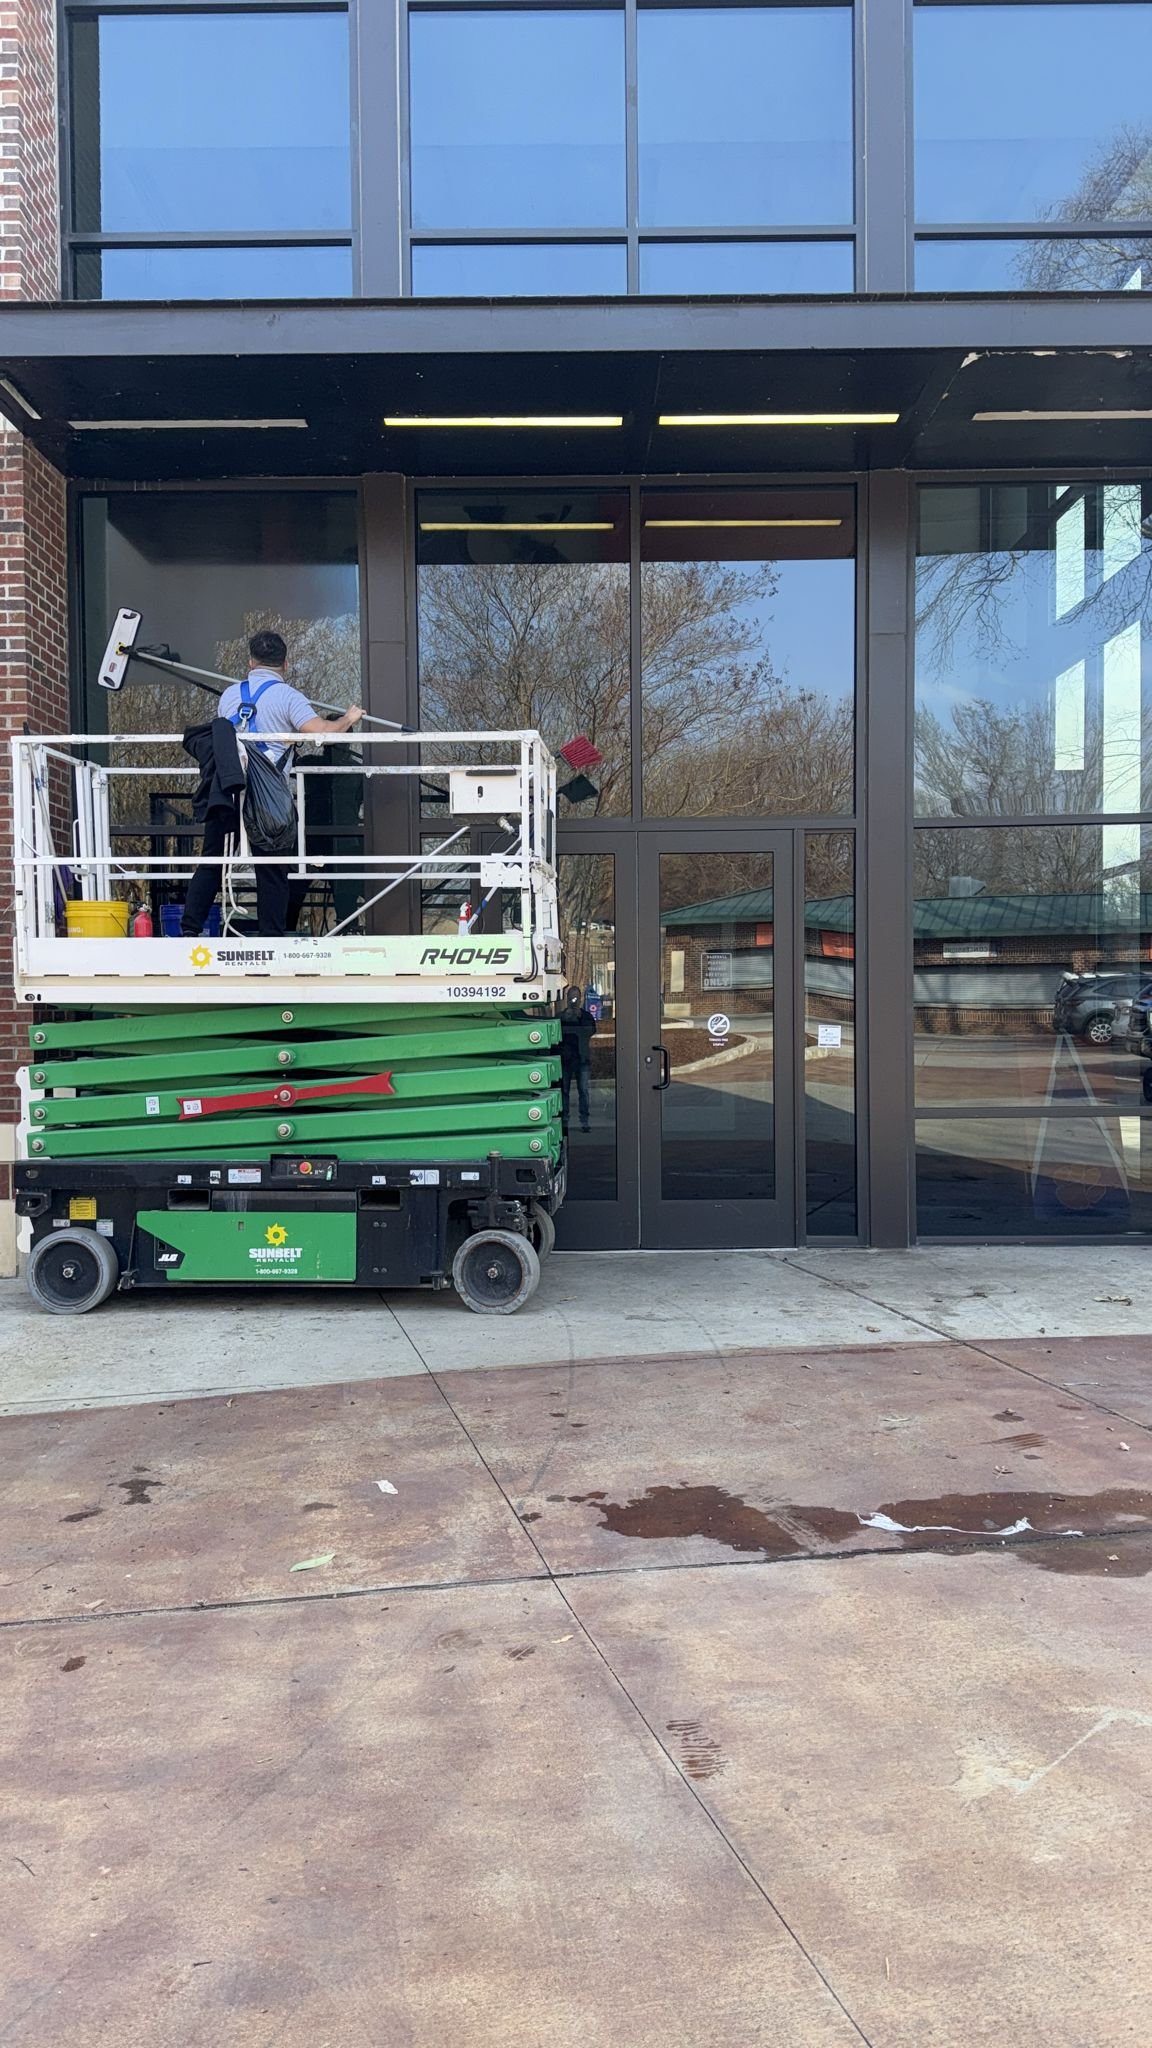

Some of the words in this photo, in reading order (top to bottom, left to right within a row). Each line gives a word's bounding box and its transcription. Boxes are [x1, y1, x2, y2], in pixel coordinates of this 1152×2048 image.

[217, 950, 275, 962] SUNBELT
[420, 948, 512, 965] R4045
[704, 978, 729, 986] ONLY
[446, 986, 506, 997] 10394192
[158, 1253, 178, 1262] JLG
[249, 1248, 303, 1258] SUNBELT
